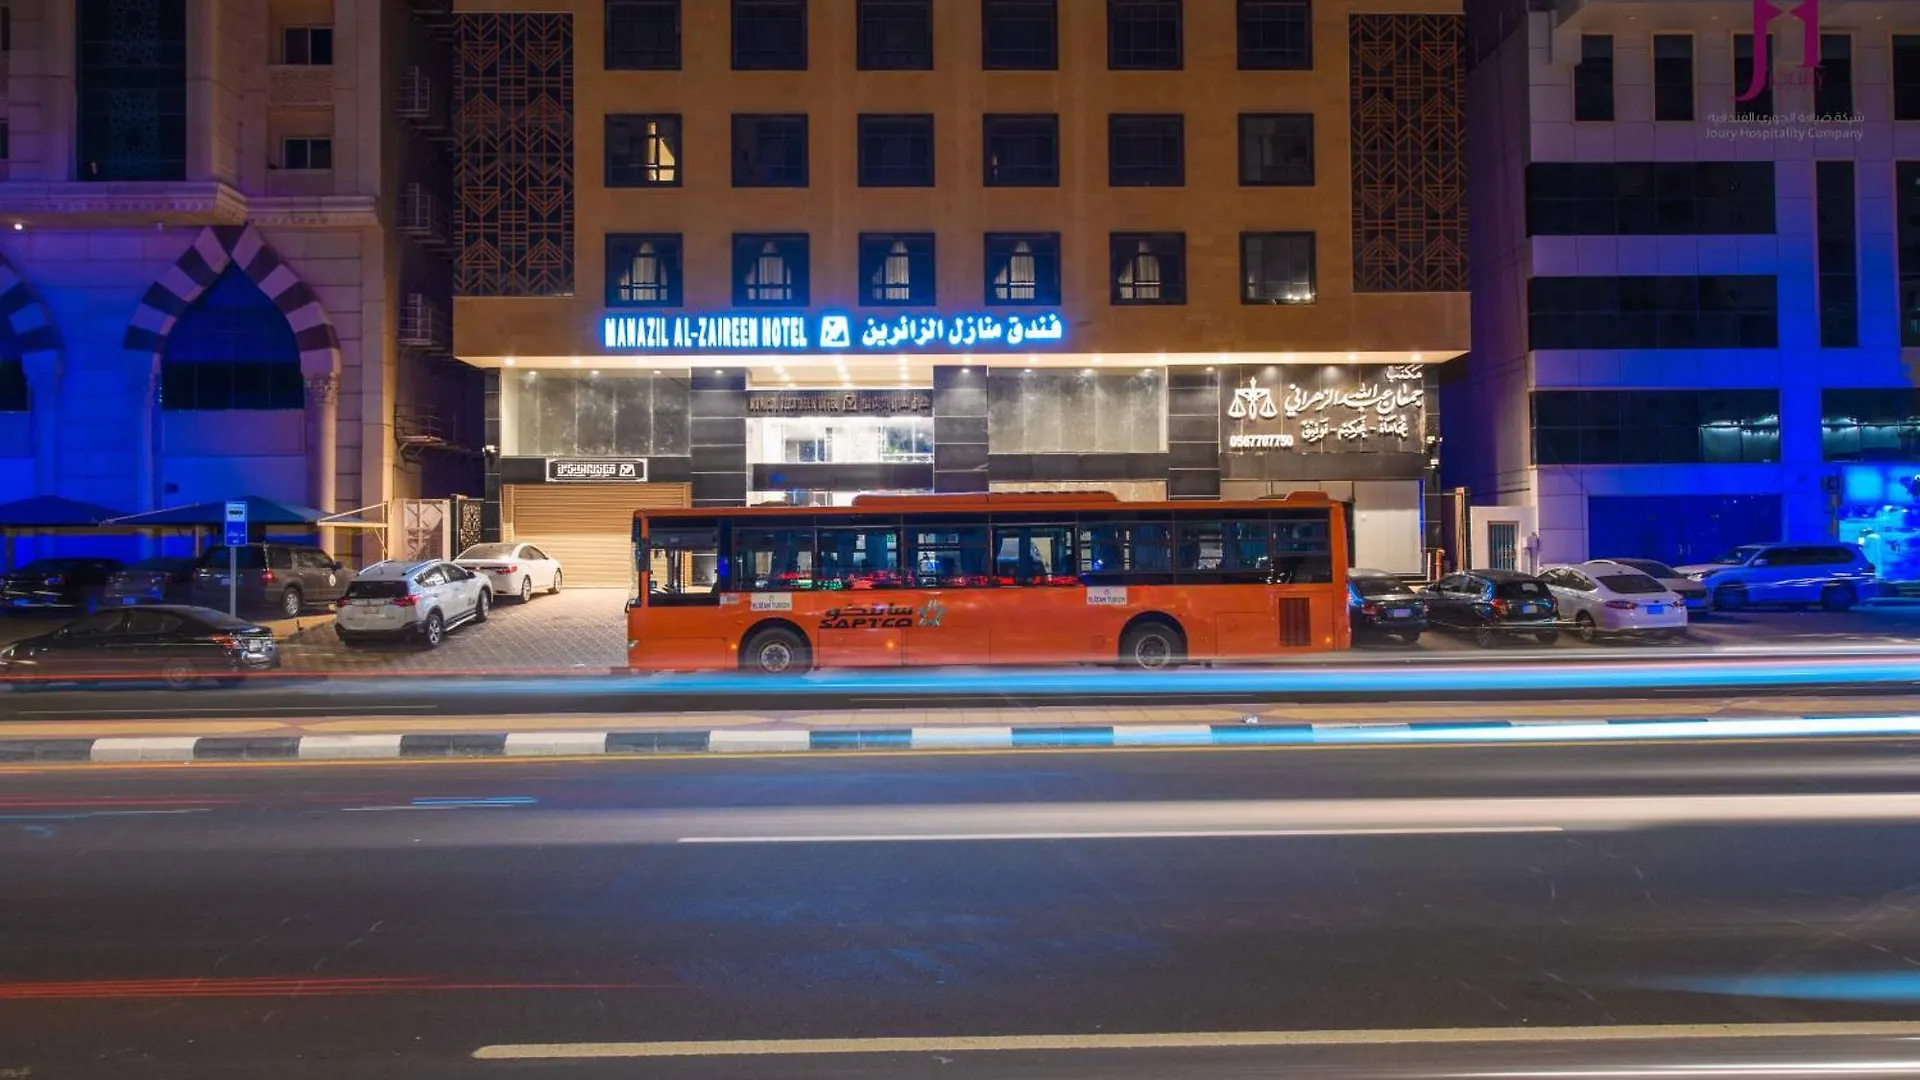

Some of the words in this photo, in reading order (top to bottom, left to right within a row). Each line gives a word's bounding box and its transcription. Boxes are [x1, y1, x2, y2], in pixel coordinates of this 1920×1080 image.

[605, 318, 669, 347] MANAZIL
[674, 317, 758, 347] AL-ZAIREEN
[762, 317, 808, 347] HOTEL
[862, 315, 944, 346] الزائرين
[948, 316, 1002, 345] منازل
[1007, 314, 1063, 344] فندق
[1386, 364, 1423, 382] مكتب
[818, 617, 914, 629] SAPTCO
